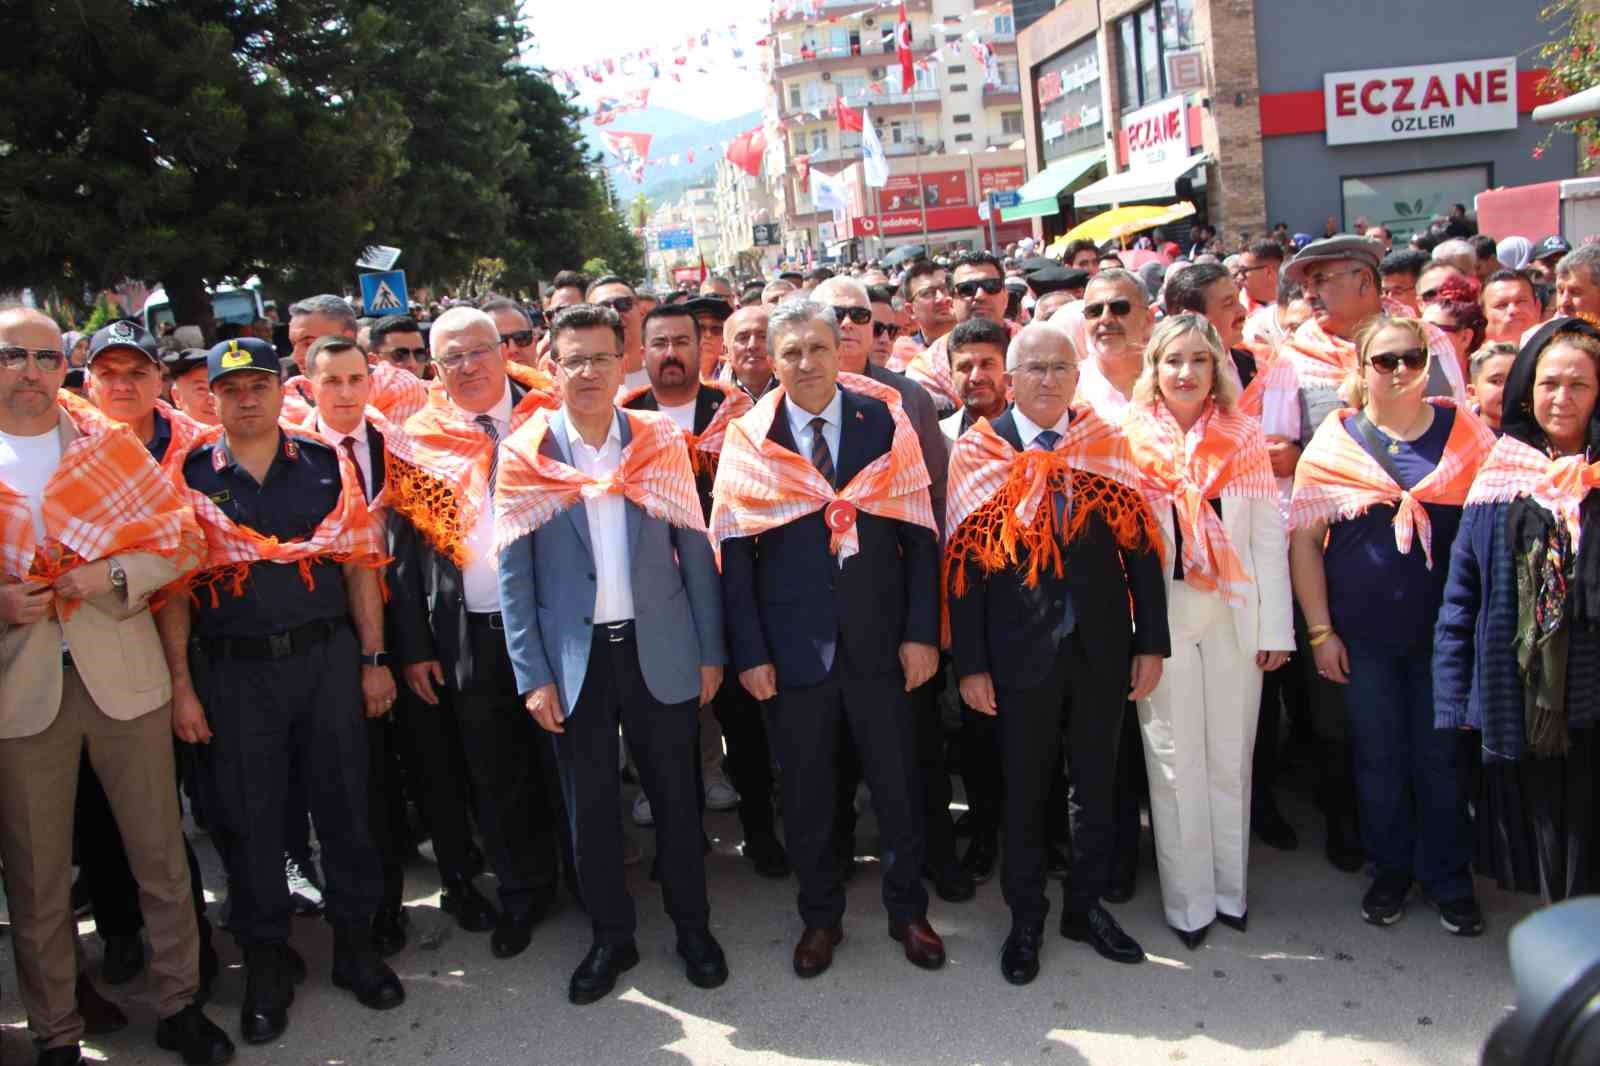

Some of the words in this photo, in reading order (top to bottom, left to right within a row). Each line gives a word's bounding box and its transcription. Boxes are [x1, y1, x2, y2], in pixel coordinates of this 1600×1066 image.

[1335, 69, 1508, 117] ECZANE
[1128, 107, 1181, 151] ECZANE
[1391, 114, 1455, 133] ÖZLEM
